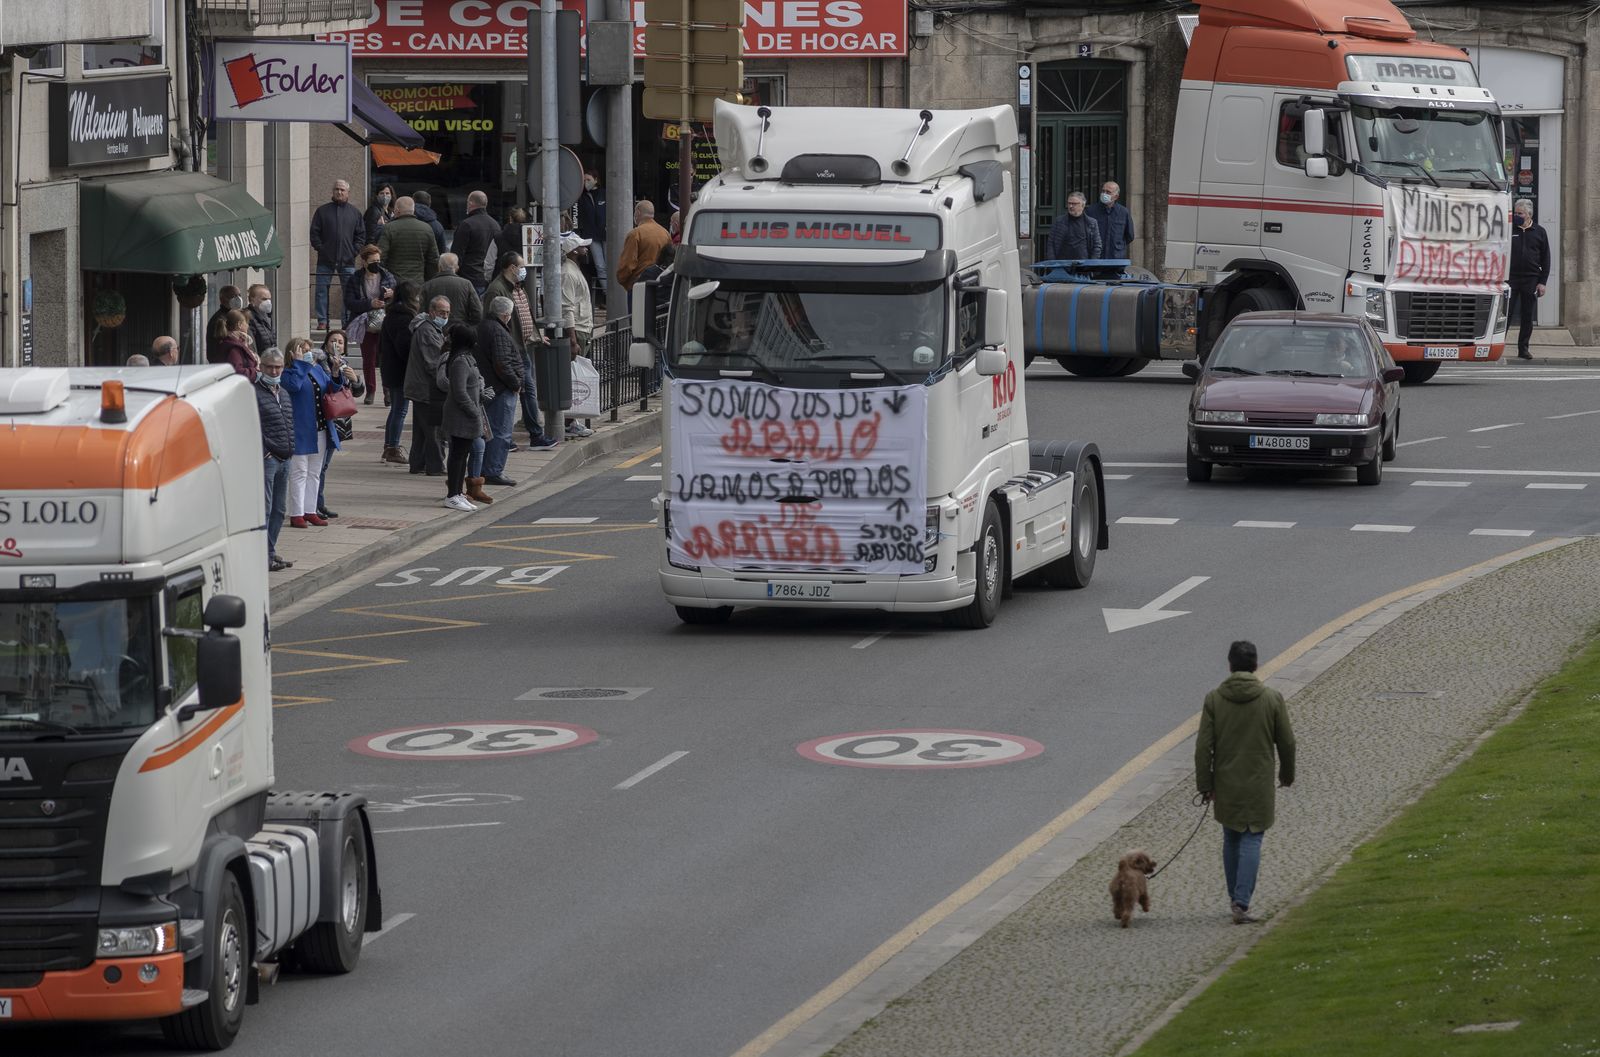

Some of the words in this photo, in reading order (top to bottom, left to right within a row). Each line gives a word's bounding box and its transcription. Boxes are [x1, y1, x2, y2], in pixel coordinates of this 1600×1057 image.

[757, 33, 792, 50] DE
[801, 33, 898, 50] HOGAR
[249, 58, 344, 94] Folder
[1376, 62, 1456, 80] MARIO
[375, 83, 464, 100] PROMOCIÓN
[69, 90, 128, 143] Milenium
[133, 106, 163, 144] Peluqueros
[445, 119, 494, 131] VISCO
[720, 221, 790, 239] LUIS
[795, 221, 912, 243] MIGUEL
[213, 233, 241, 263] ARCO
[238, 229, 260, 258] IRIS
[1429, 348, 1445, 357] 4419
[679, 382, 781, 420] SOMOS
[790, 391, 830, 420] LOS
[833, 390, 873, 420] DE
[677, 471, 782, 504] VAMOS
[864, 464, 912, 497] LOS
[22, 501, 98, 524] LOLO
[859, 523, 919, 542] STOP
[853, 542, 925, 564] ABUSOS
[375, 565, 571, 587] BUS
[775, 585, 804, 597] 7864
[809, 585, 831, 597] JDZ
[385, 728, 559, 752] 30
[833, 736, 1002, 762] 30
